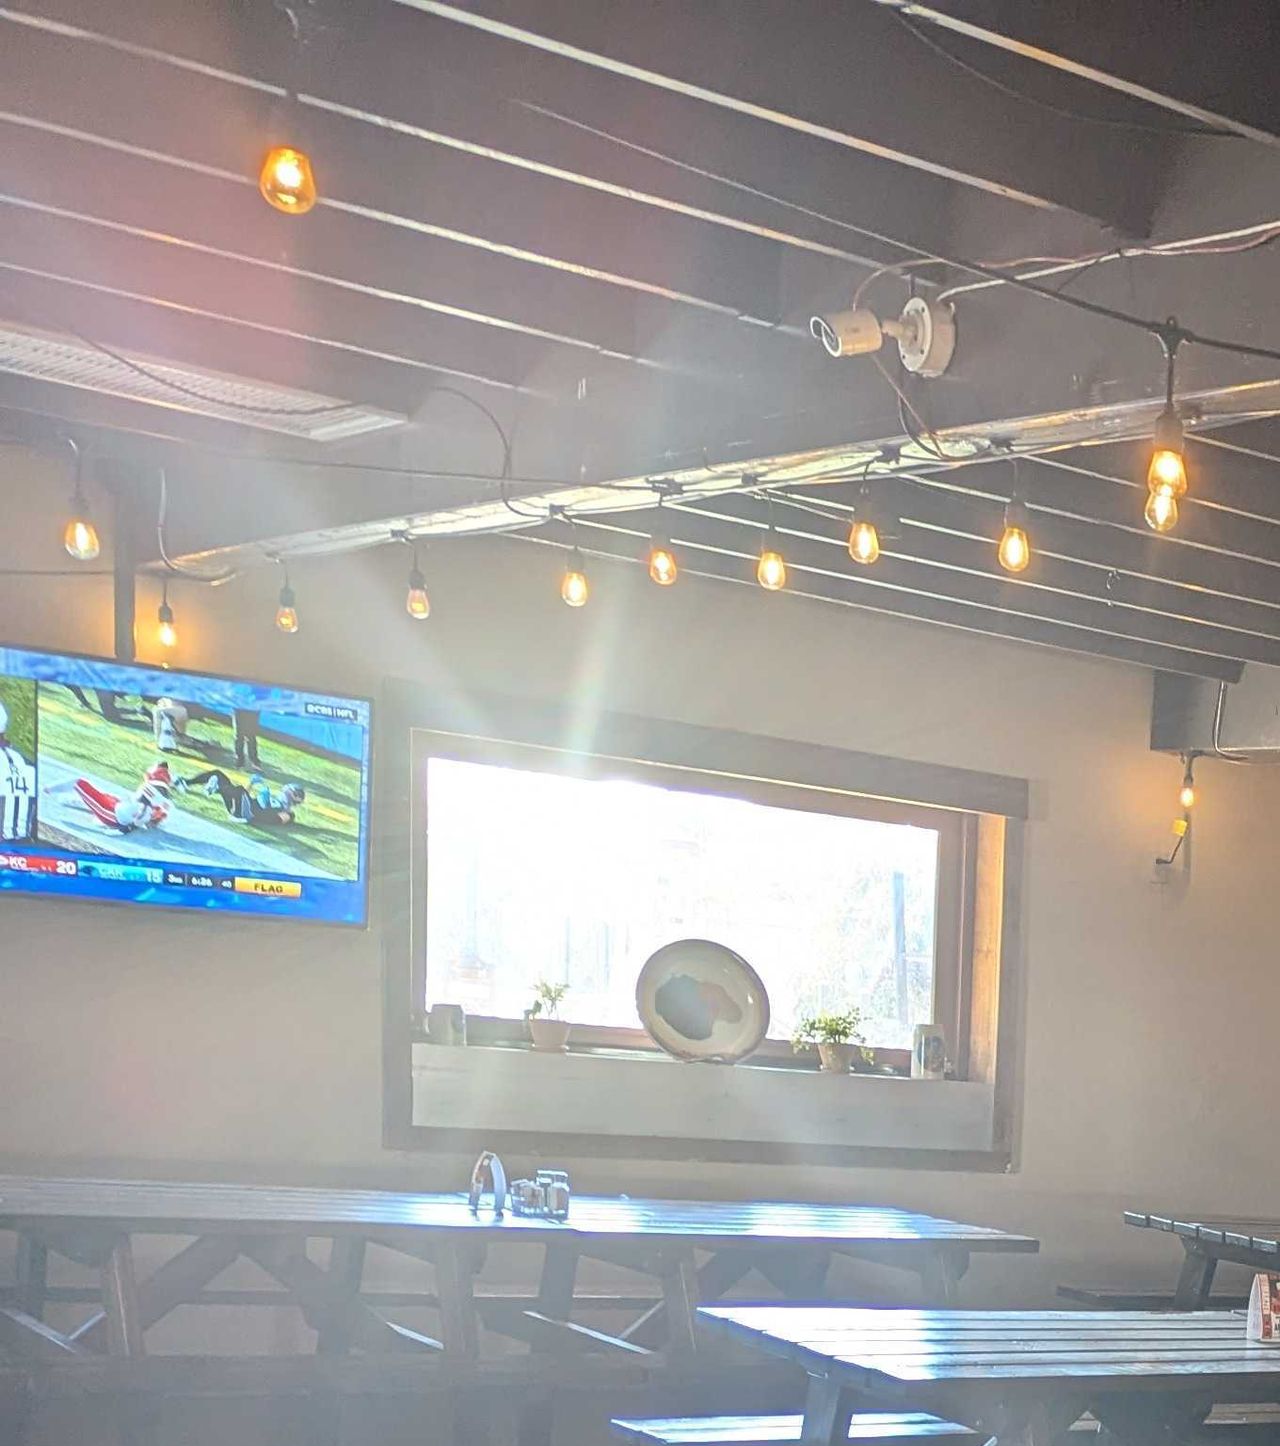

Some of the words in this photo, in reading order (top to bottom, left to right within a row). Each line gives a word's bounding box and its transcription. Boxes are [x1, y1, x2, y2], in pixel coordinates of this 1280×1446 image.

[6, 776, 29, 794] 14
[9, 856, 27, 868] KC
[56, 860, 77, 875] 20
[254, 882, 283, 893] FLAG
